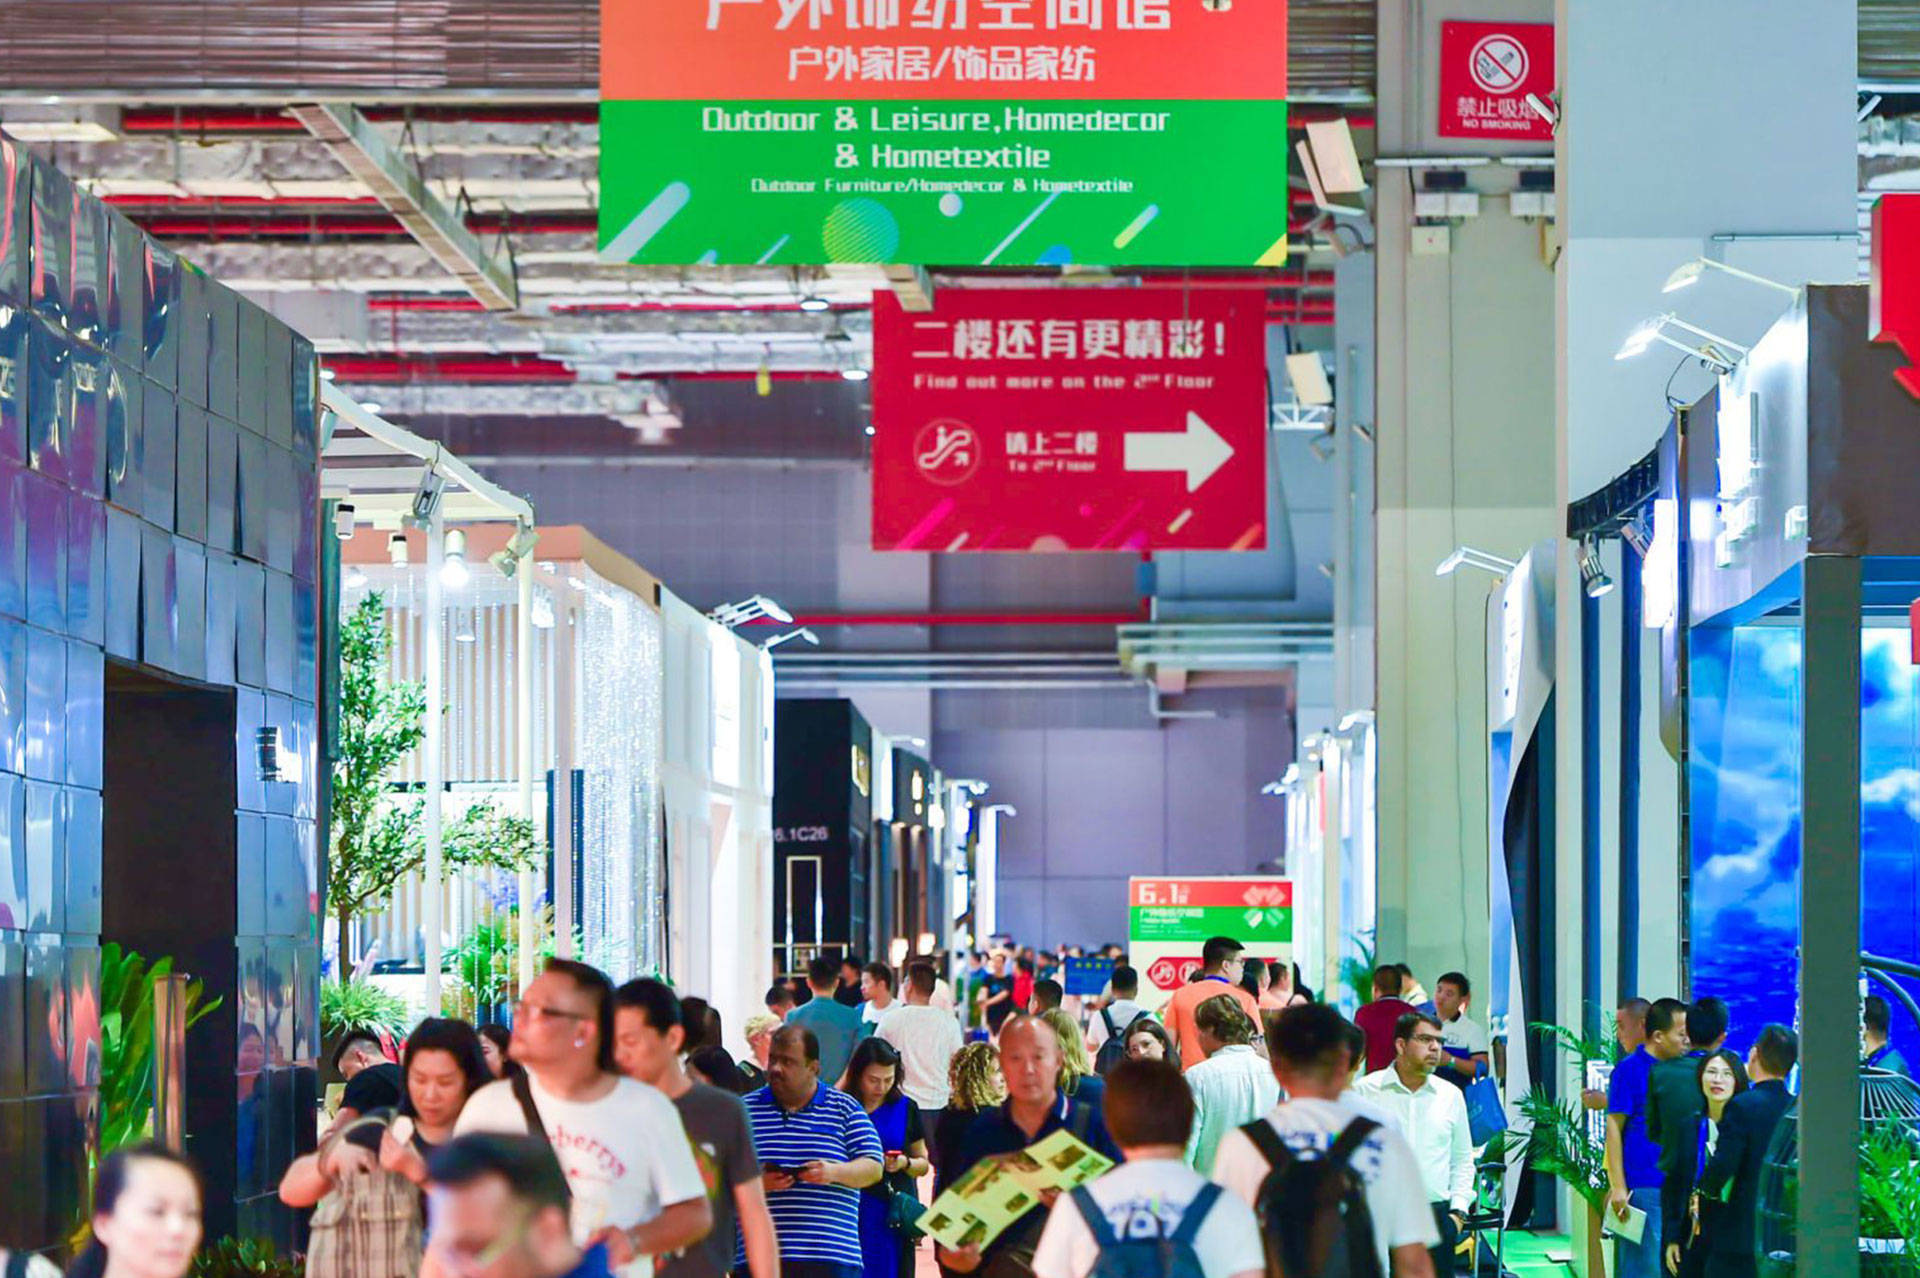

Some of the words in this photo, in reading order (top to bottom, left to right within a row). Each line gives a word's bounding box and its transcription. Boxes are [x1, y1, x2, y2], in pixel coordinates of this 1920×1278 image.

[788, 46, 1096, 81] 户外家居/饰品家纺
[702, 107, 820, 131] Outdoor
[834, 107, 859, 131] &
[1462, 117, 1479, 128] NO
[1481, 119, 1531, 130] SMOKING
[834, 144, 859, 168] &
[872, 144, 1050, 168] Hometextile
[751, 178, 815, 192] Outdoor
[1013, 178, 1026, 192] &
[1033, 178, 1133, 192] Hometextile
[914, 374, 958, 389] Find
[966, 375, 997, 389] out
[1006, 376, 1053, 389] more
[1062, 376, 1085, 389] on
[1094, 374, 1125, 389] the
[1164, 374, 1214, 389] Floor
[1006, 431, 1098, 455] 请上二楼
